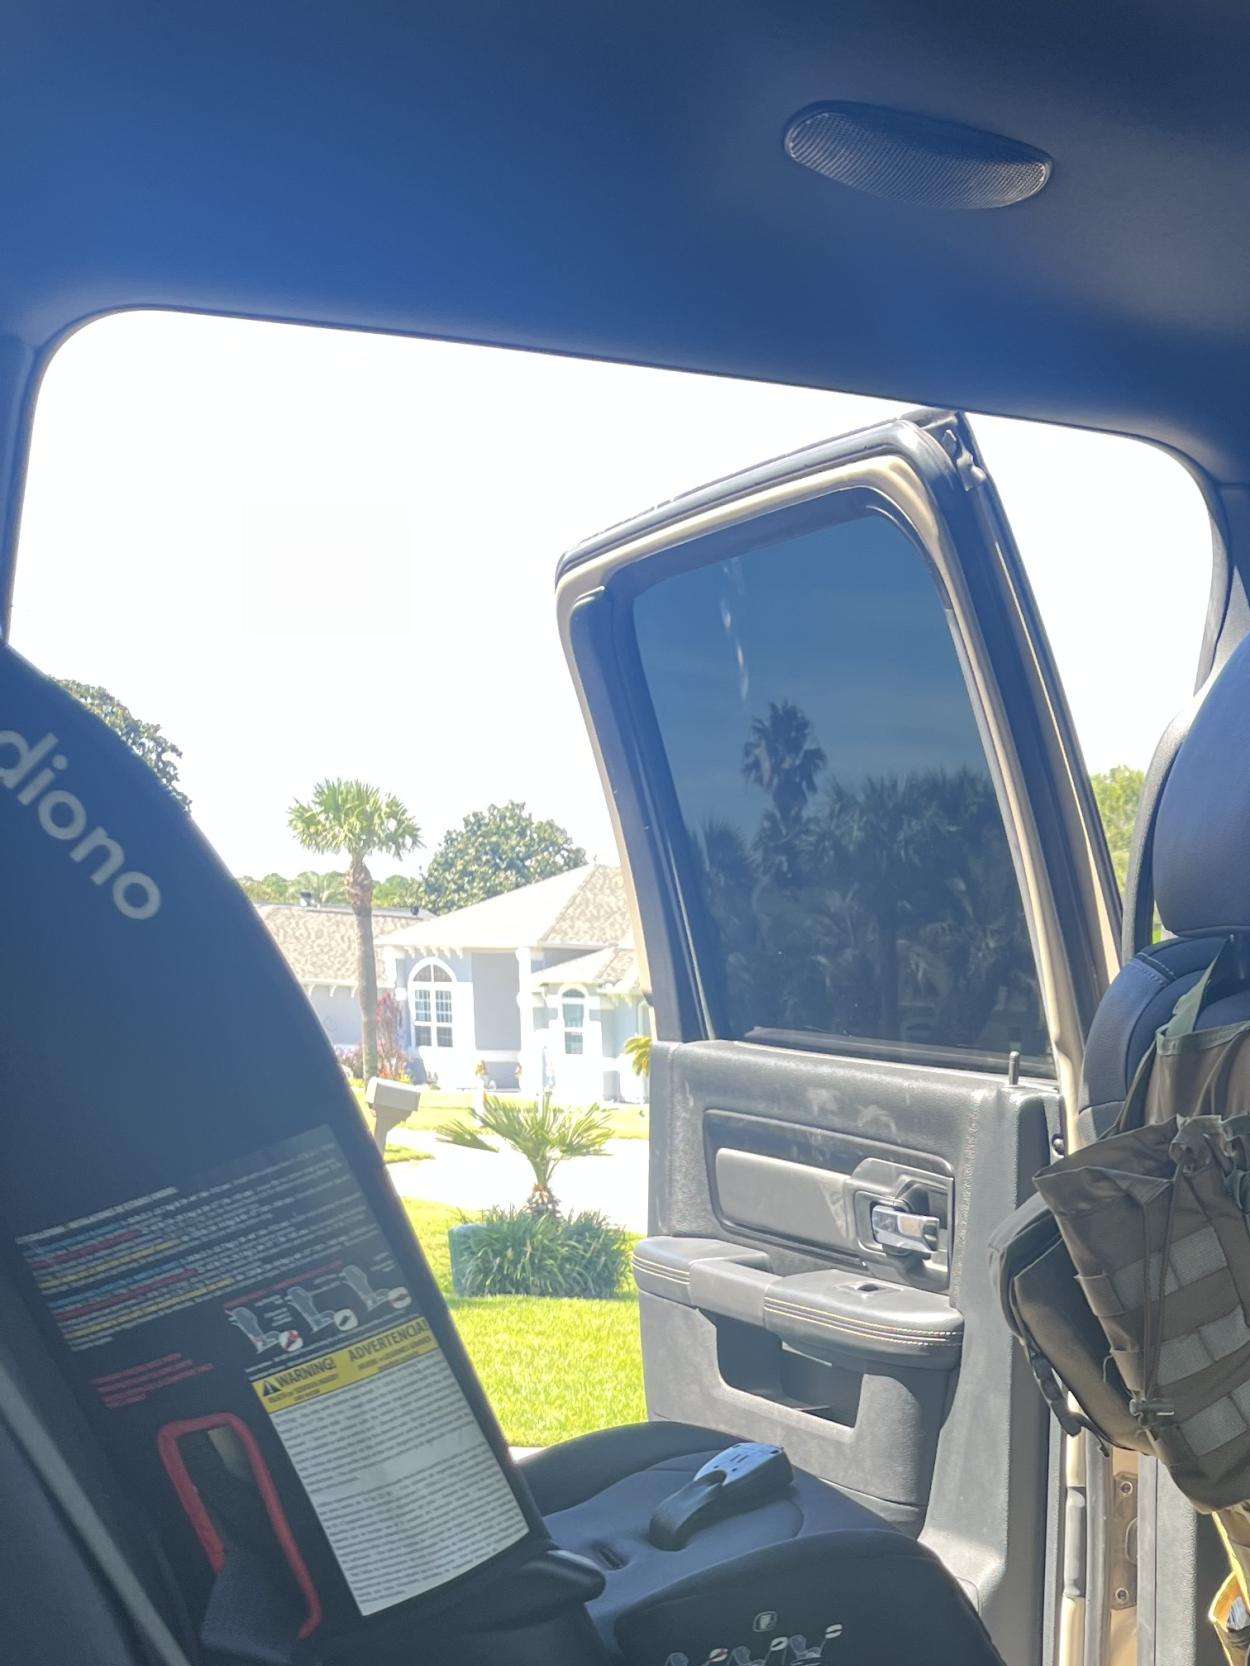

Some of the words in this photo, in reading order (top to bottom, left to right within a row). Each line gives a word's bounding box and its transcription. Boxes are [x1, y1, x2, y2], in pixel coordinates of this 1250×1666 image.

[0, 730, 161, 920] diono
[275, 1356, 337, 1388] WARNING!
[349, 1317, 429, 1362] ADVERTENCIA!
